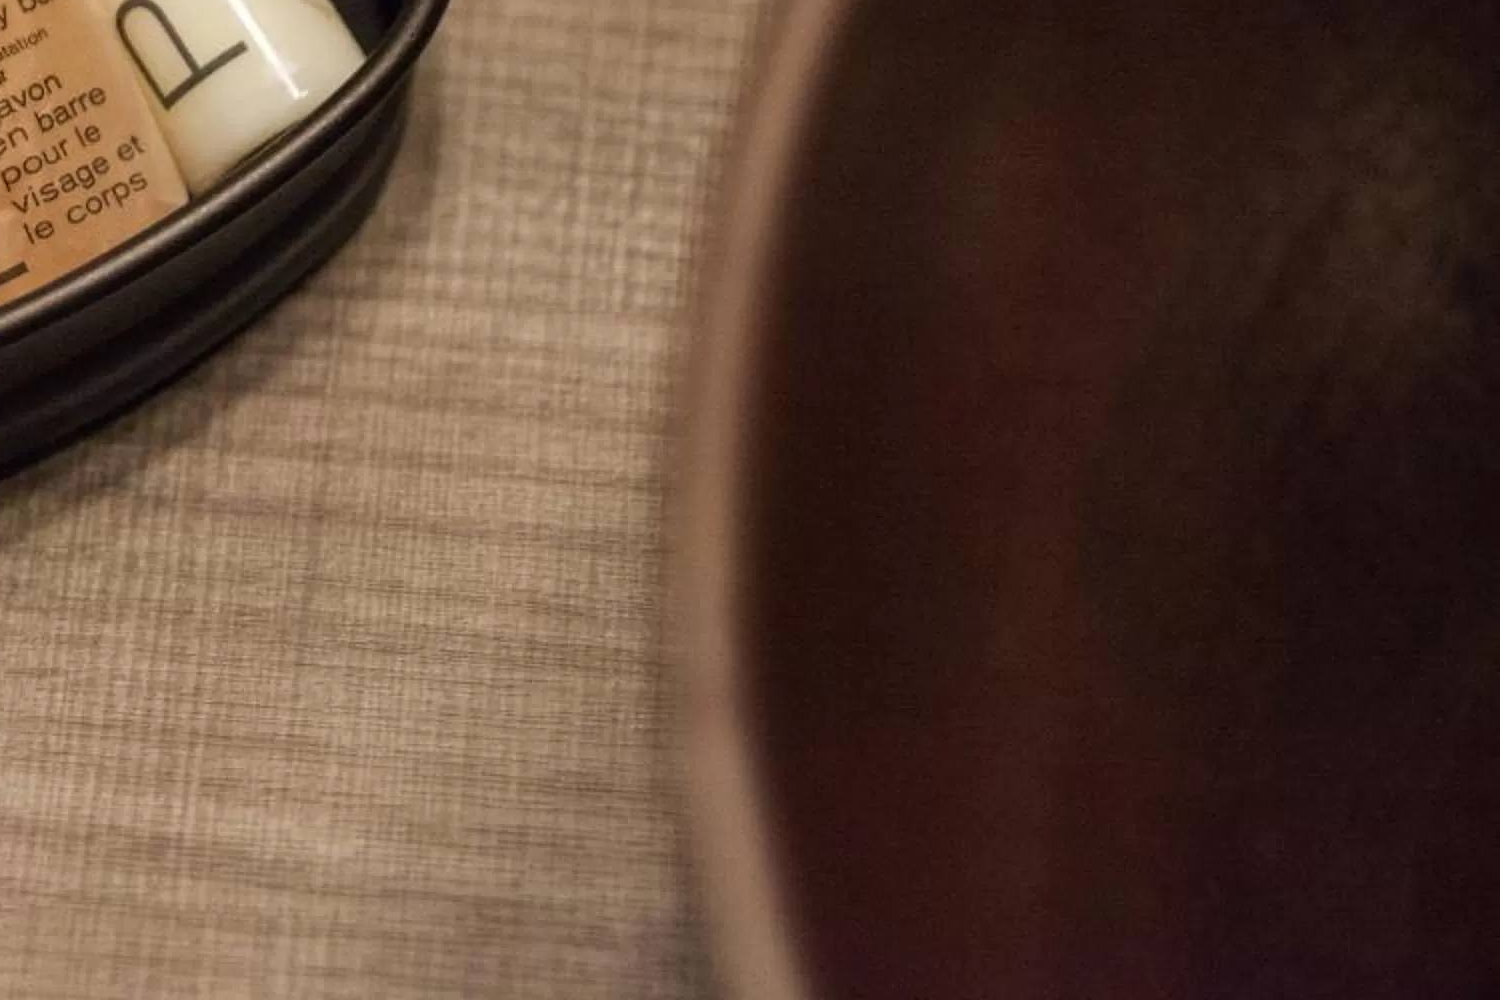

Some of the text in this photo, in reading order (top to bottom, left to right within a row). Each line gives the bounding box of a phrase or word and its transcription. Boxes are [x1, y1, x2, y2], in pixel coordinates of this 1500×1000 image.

[34, 87, 107, 134] barre
[0, 124, 102, 193] pour le
[11, 135, 146, 214] visage et
[23, 171, 149, 246] le corps
